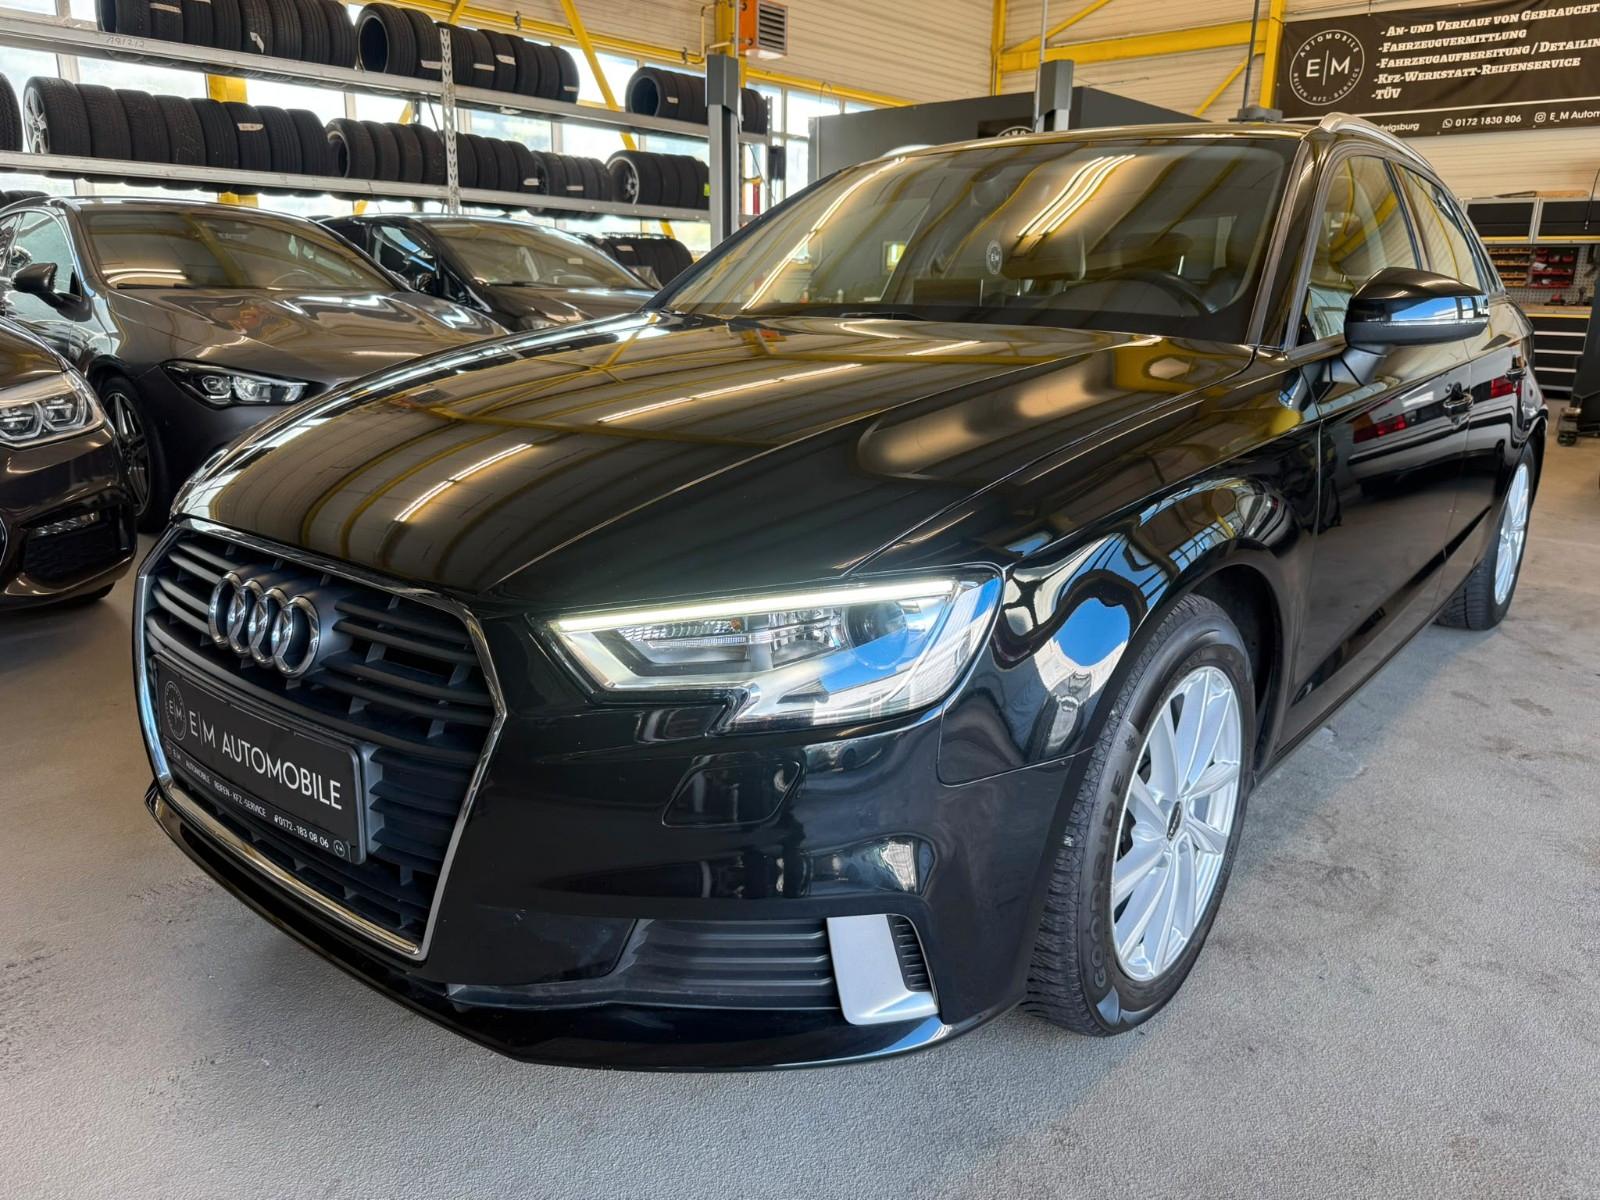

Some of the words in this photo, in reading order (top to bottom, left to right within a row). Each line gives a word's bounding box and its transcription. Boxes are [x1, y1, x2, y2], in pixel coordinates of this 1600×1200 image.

[1436, 16, 1491, 31] VERKAUF
[1493, 13, 1519, 24] VON
[1299, 33, 1360, 58] AUTOMOBILE
[1455, 118, 1478, 127] 0172
[1481, 116, 1502, 125] 1830
[1504, 115, 1522, 124] 806
[222, 731, 342, 810] AUTOMOBILE
